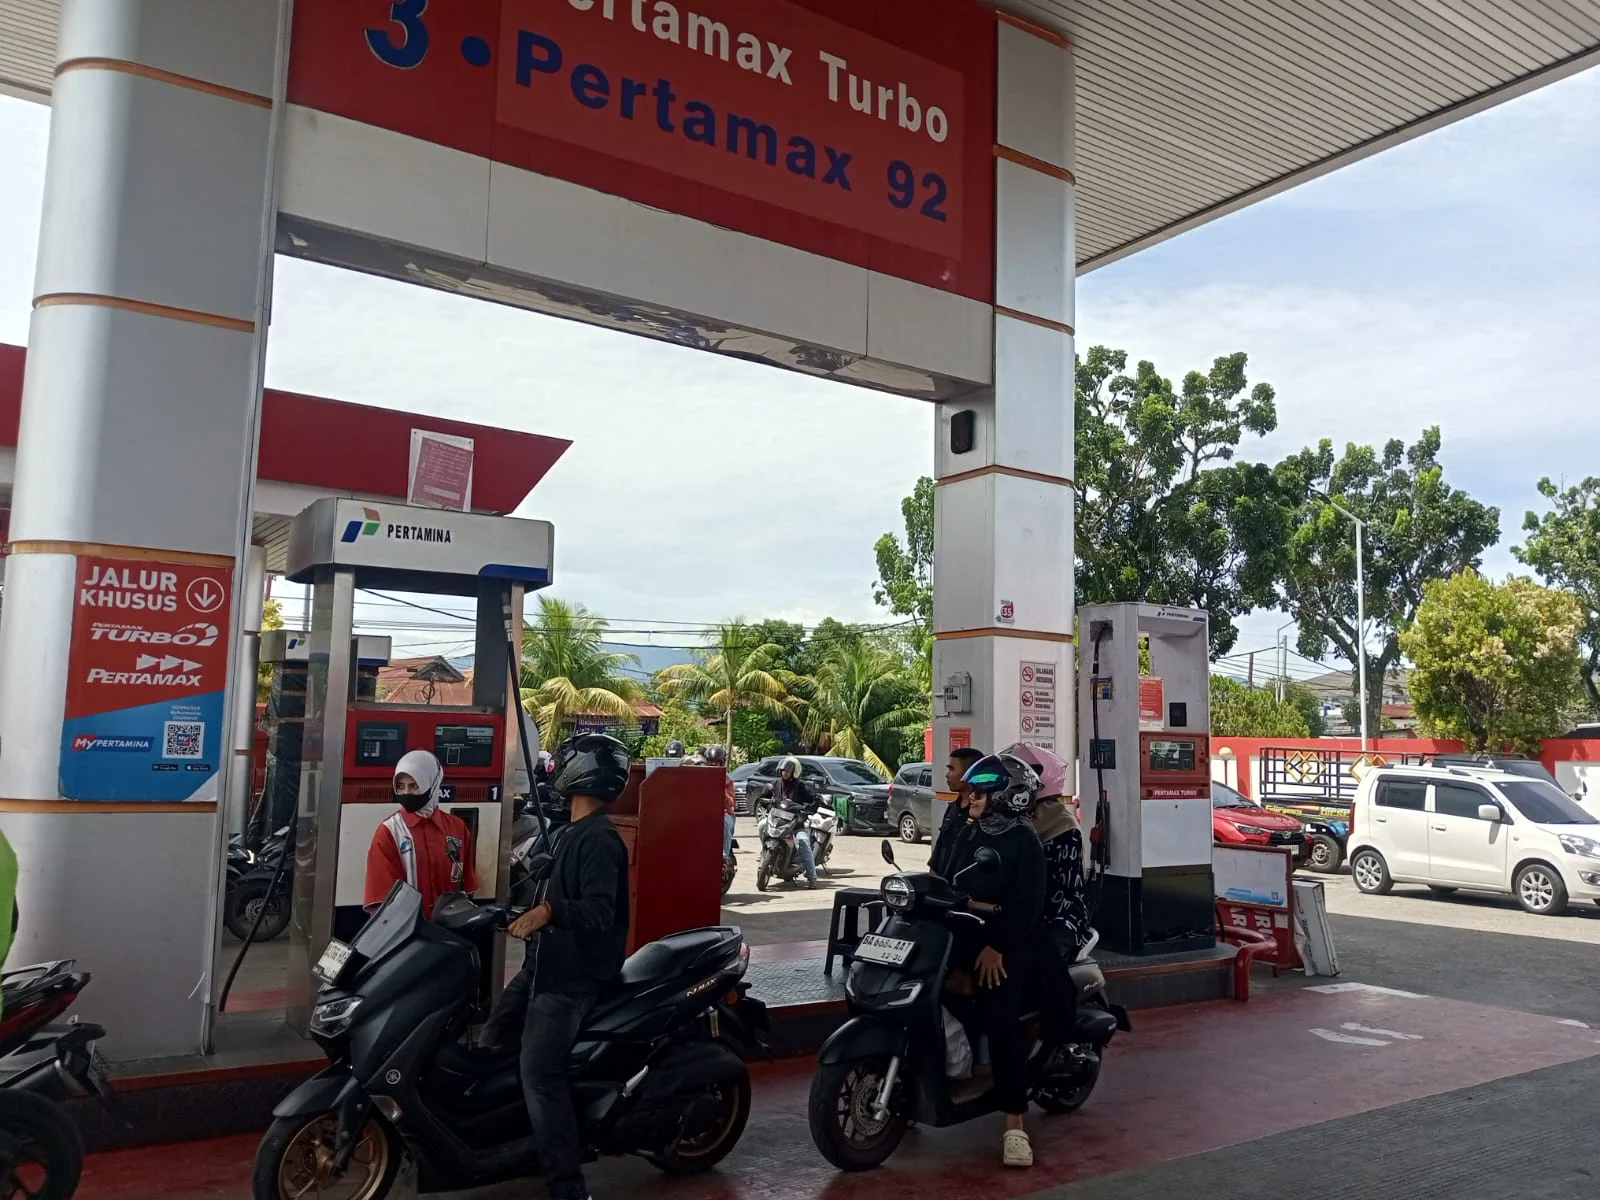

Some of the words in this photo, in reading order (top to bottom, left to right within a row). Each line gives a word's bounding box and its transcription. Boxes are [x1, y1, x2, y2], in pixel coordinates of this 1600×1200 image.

[568, 0, 793, 85] rtamax
[818, 50, 948, 142] Turbo
[365, 0, 429, 69] 3
[515, 29, 853, 191] Pertamax
[886, 159, 948, 220] 92
[387, 524, 451, 544] PERTAMINA
[84, 566, 178, 592] JALUR
[80, 588, 178, 612] KHUSUS
[91, 621, 144, 631] PERTAMAX
[90, 628, 198, 646] TURBO
[86, 668, 204, 687] PERTAMAX
[490, 786, 498, 800] 1
